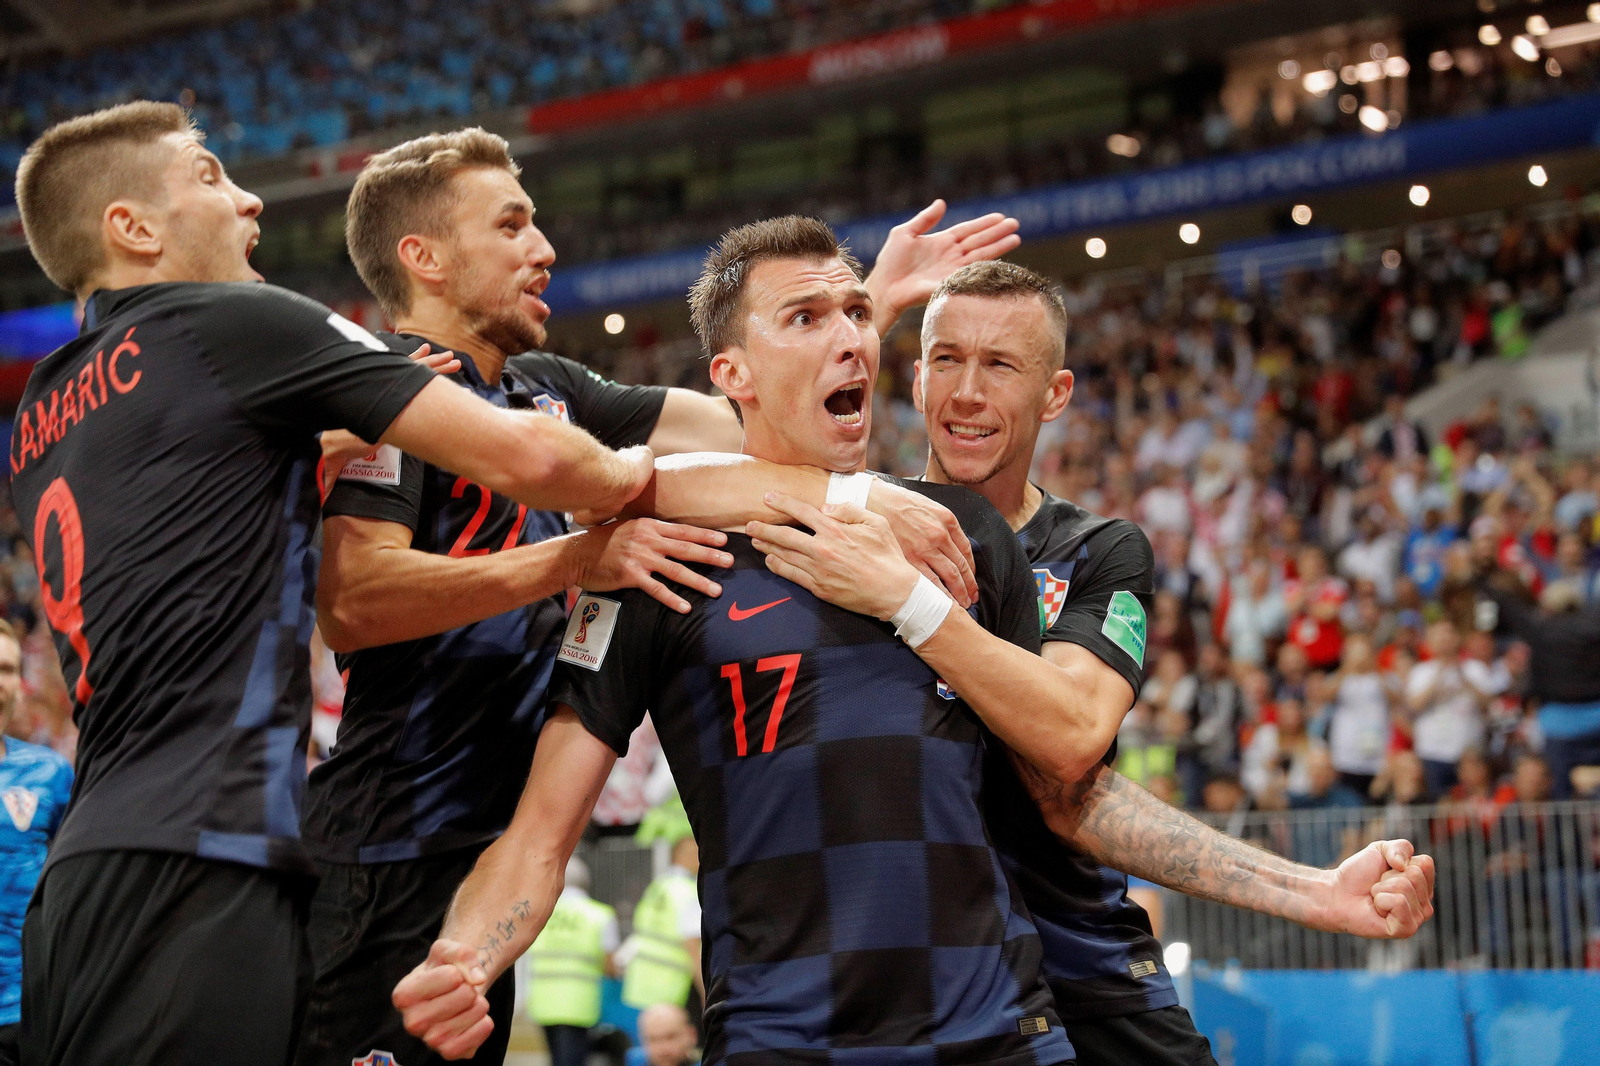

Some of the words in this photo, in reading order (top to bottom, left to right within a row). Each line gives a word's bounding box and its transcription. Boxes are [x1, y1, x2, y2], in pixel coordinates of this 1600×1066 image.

[375, 471, 395, 479] 2018
[34, 476, 93, 704] 9
[579, 652, 598, 664] 2018
[721, 653, 802, 757] 17
